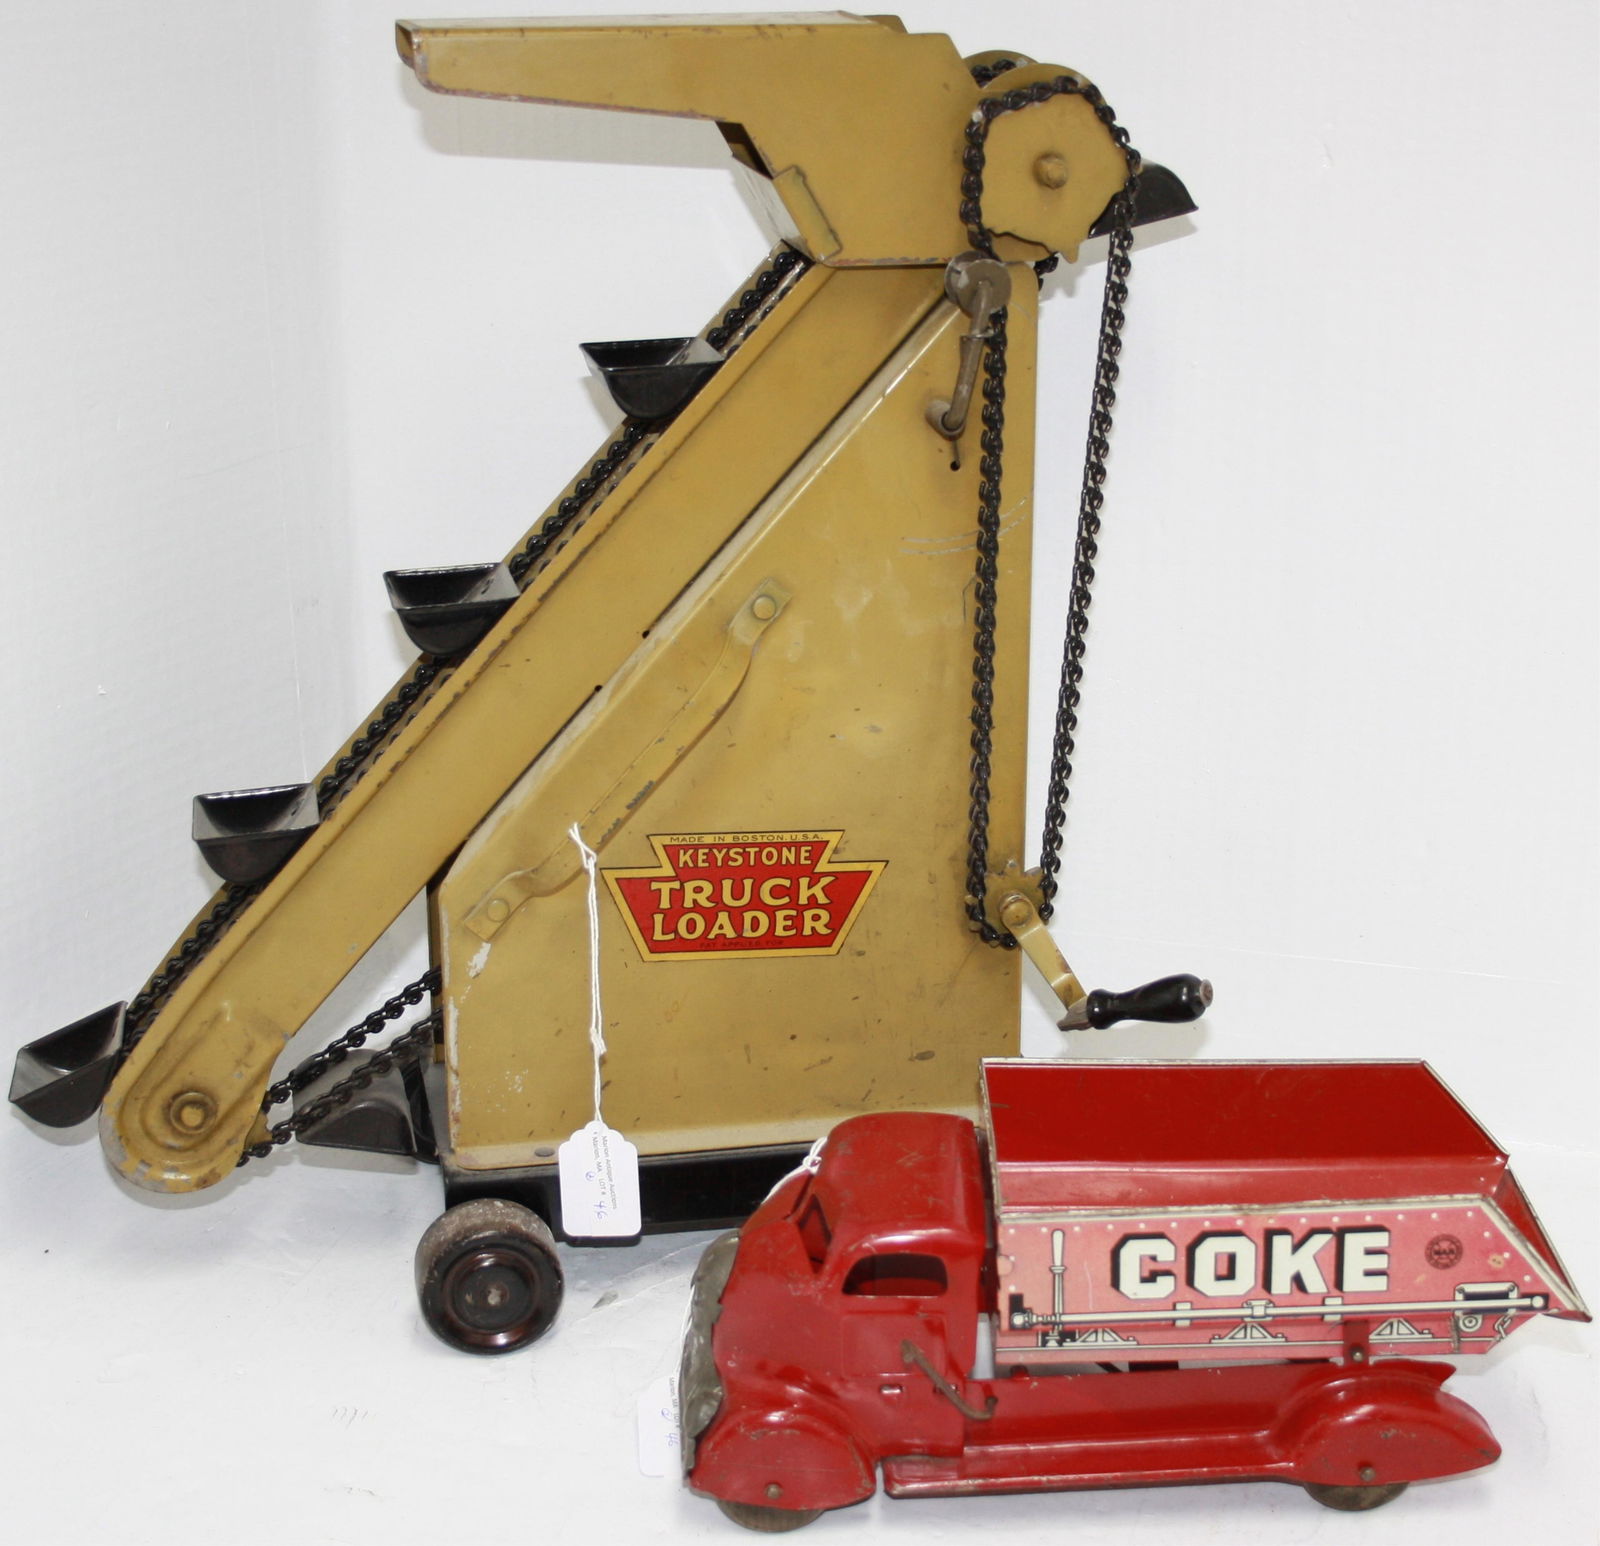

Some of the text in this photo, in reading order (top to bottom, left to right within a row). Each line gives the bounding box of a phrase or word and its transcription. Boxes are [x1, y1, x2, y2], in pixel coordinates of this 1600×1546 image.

[669, 835, 705, 844] MADE
[713, 835, 726, 843] IN
[678, 845, 813, 869] KEYSTONE
[650, 875, 836, 910] TRUCK
[651, 907, 833, 942] LOADER
[594, 1200, 608, 1221] 46
[1111, 1225, 1391, 1301] COKE
